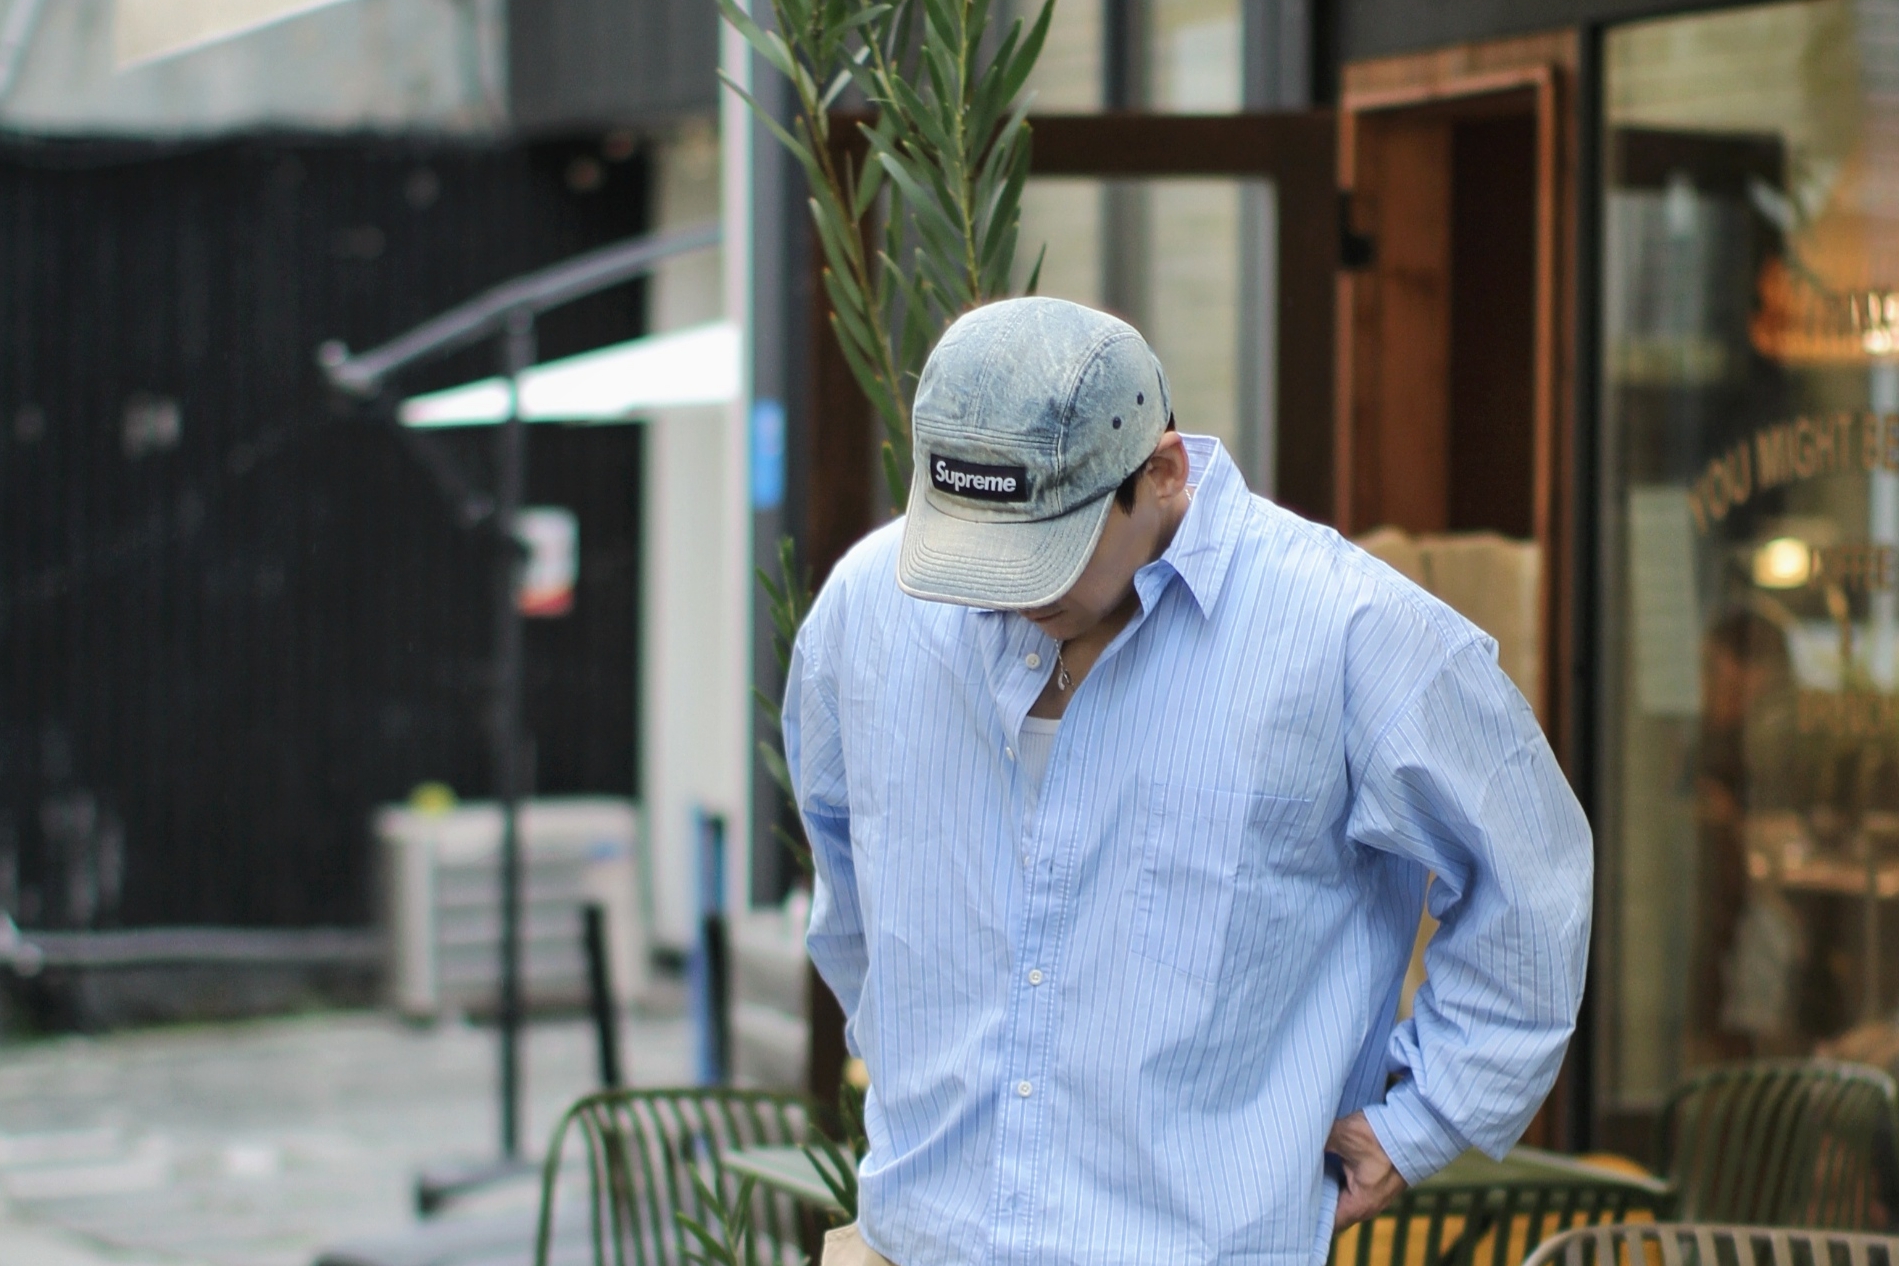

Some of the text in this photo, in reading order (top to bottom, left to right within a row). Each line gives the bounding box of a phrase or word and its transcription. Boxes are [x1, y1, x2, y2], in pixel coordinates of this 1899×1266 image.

[935, 460, 1017, 493] Supreme
[1687, 440, 1752, 532] YOU
[1755, 413, 1855, 488] MIGHT
